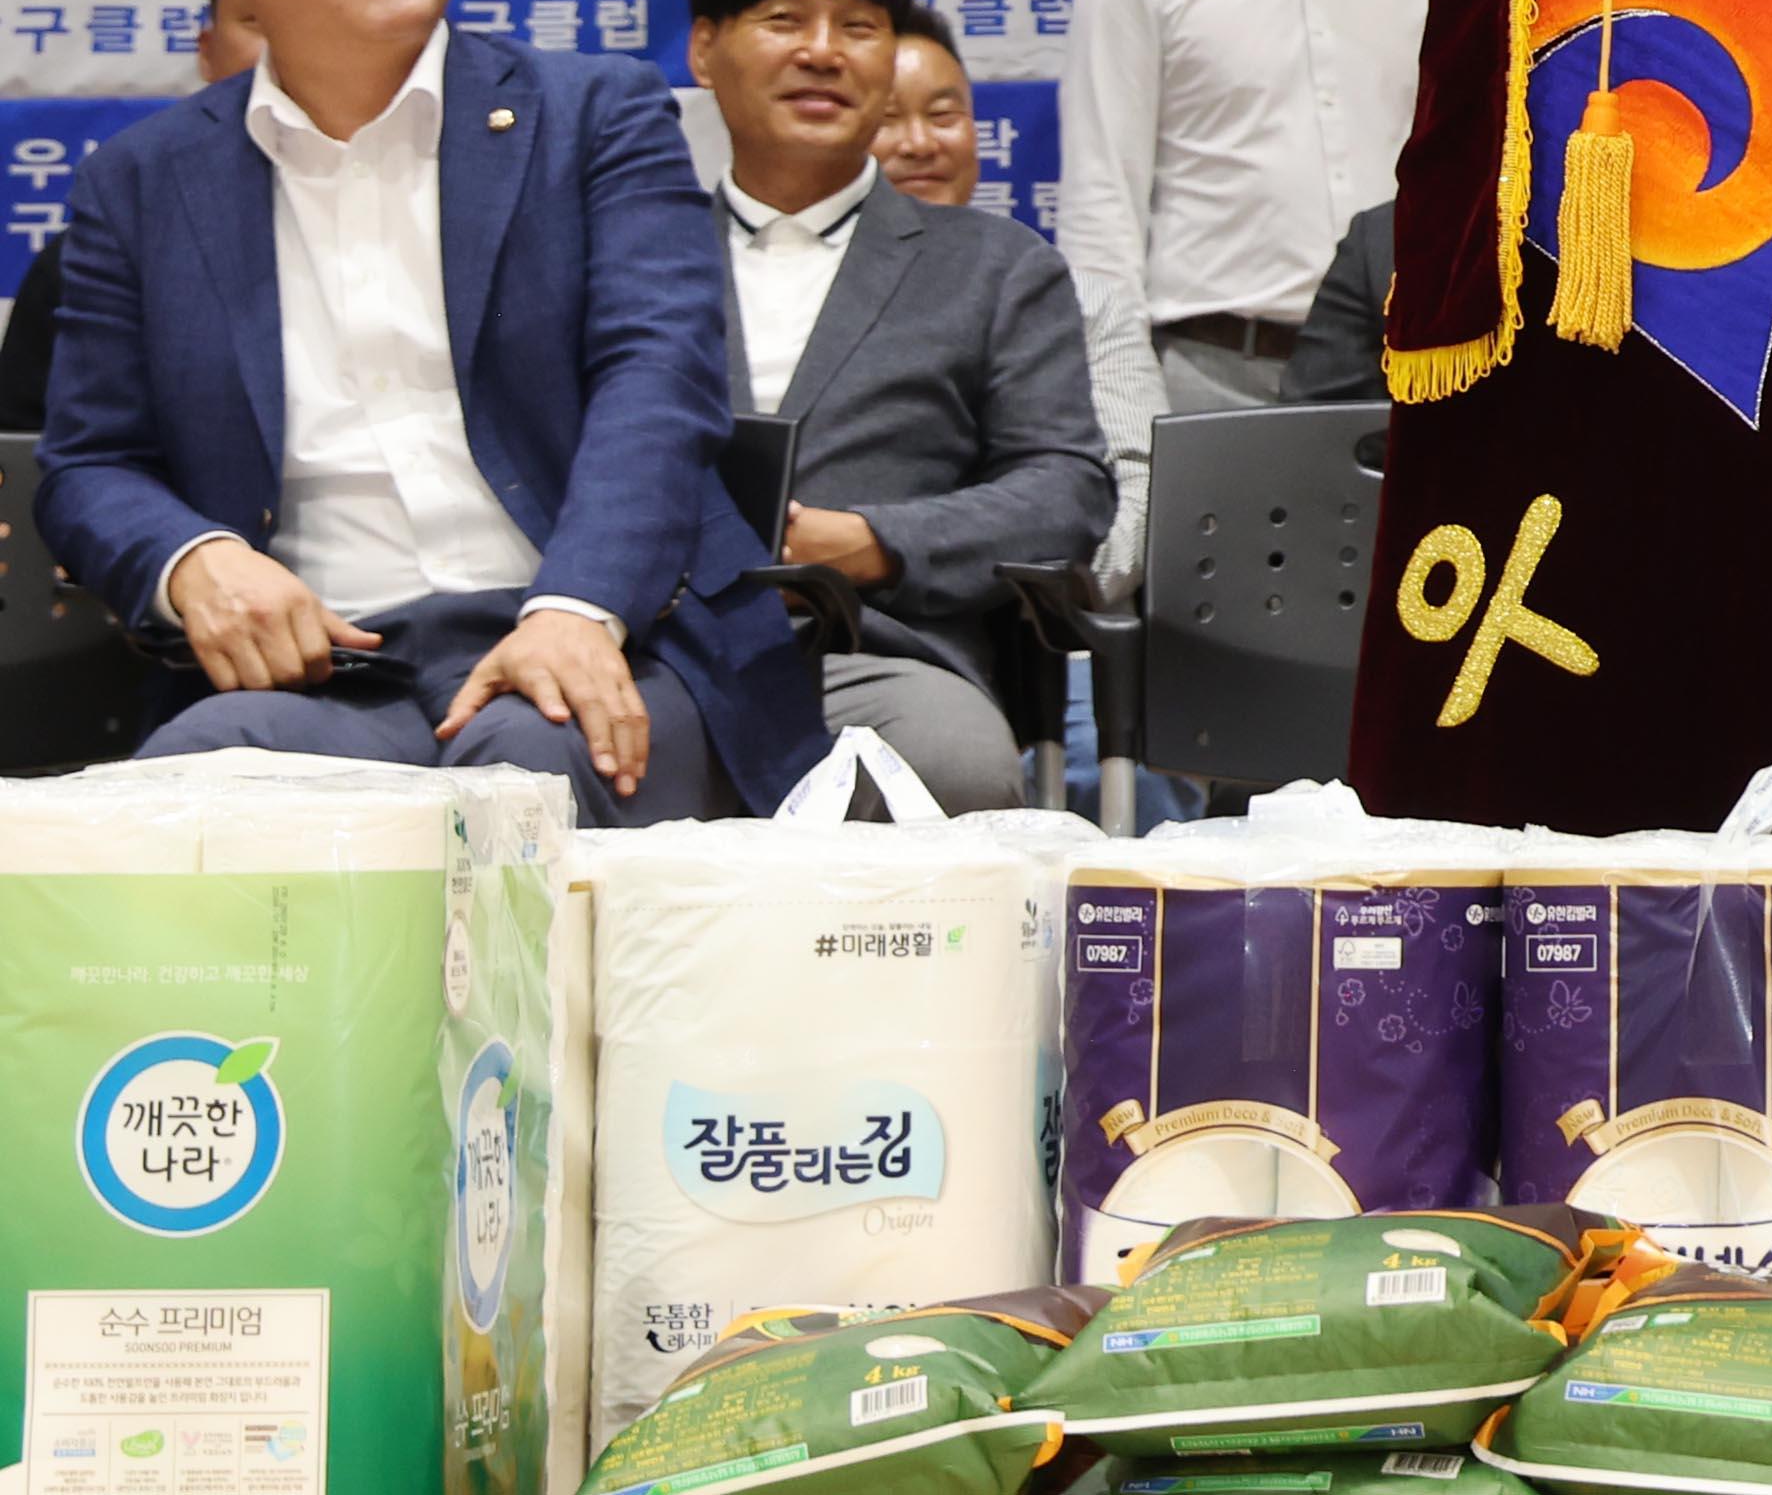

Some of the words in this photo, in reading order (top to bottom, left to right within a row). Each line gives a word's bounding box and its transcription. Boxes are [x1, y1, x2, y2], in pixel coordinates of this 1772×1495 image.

[0, 2, 211, 55] 구클럽
[1095, 905, 1144, 924] 유한킴벌리
[1547, 905, 1597, 922] 유한킴벌리
[1086, 943, 1129, 963] 07987
[1537, 943, 1582, 962] 07987
[121, 1095, 244, 1138] 깨끗한
[1154, 1109, 1220, 1136] Premium
[1616, 1106, 1680, 1136] Premium
[142, 1145, 221, 1183] 나라
[683, 1110, 913, 1194] 잘풀리는집
[861, 1205, 935, 1237] Origin
[1382, 1252, 1402, 1269] 4
[99, 1307, 150, 1337] 순수
[157, 1306, 263, 1336] 프리미엄
[642, 1304, 714, 1330] 도톰함
[179, 1341, 233, 1353] PREMIUM
[863, 1365, 883, 1384] 4
